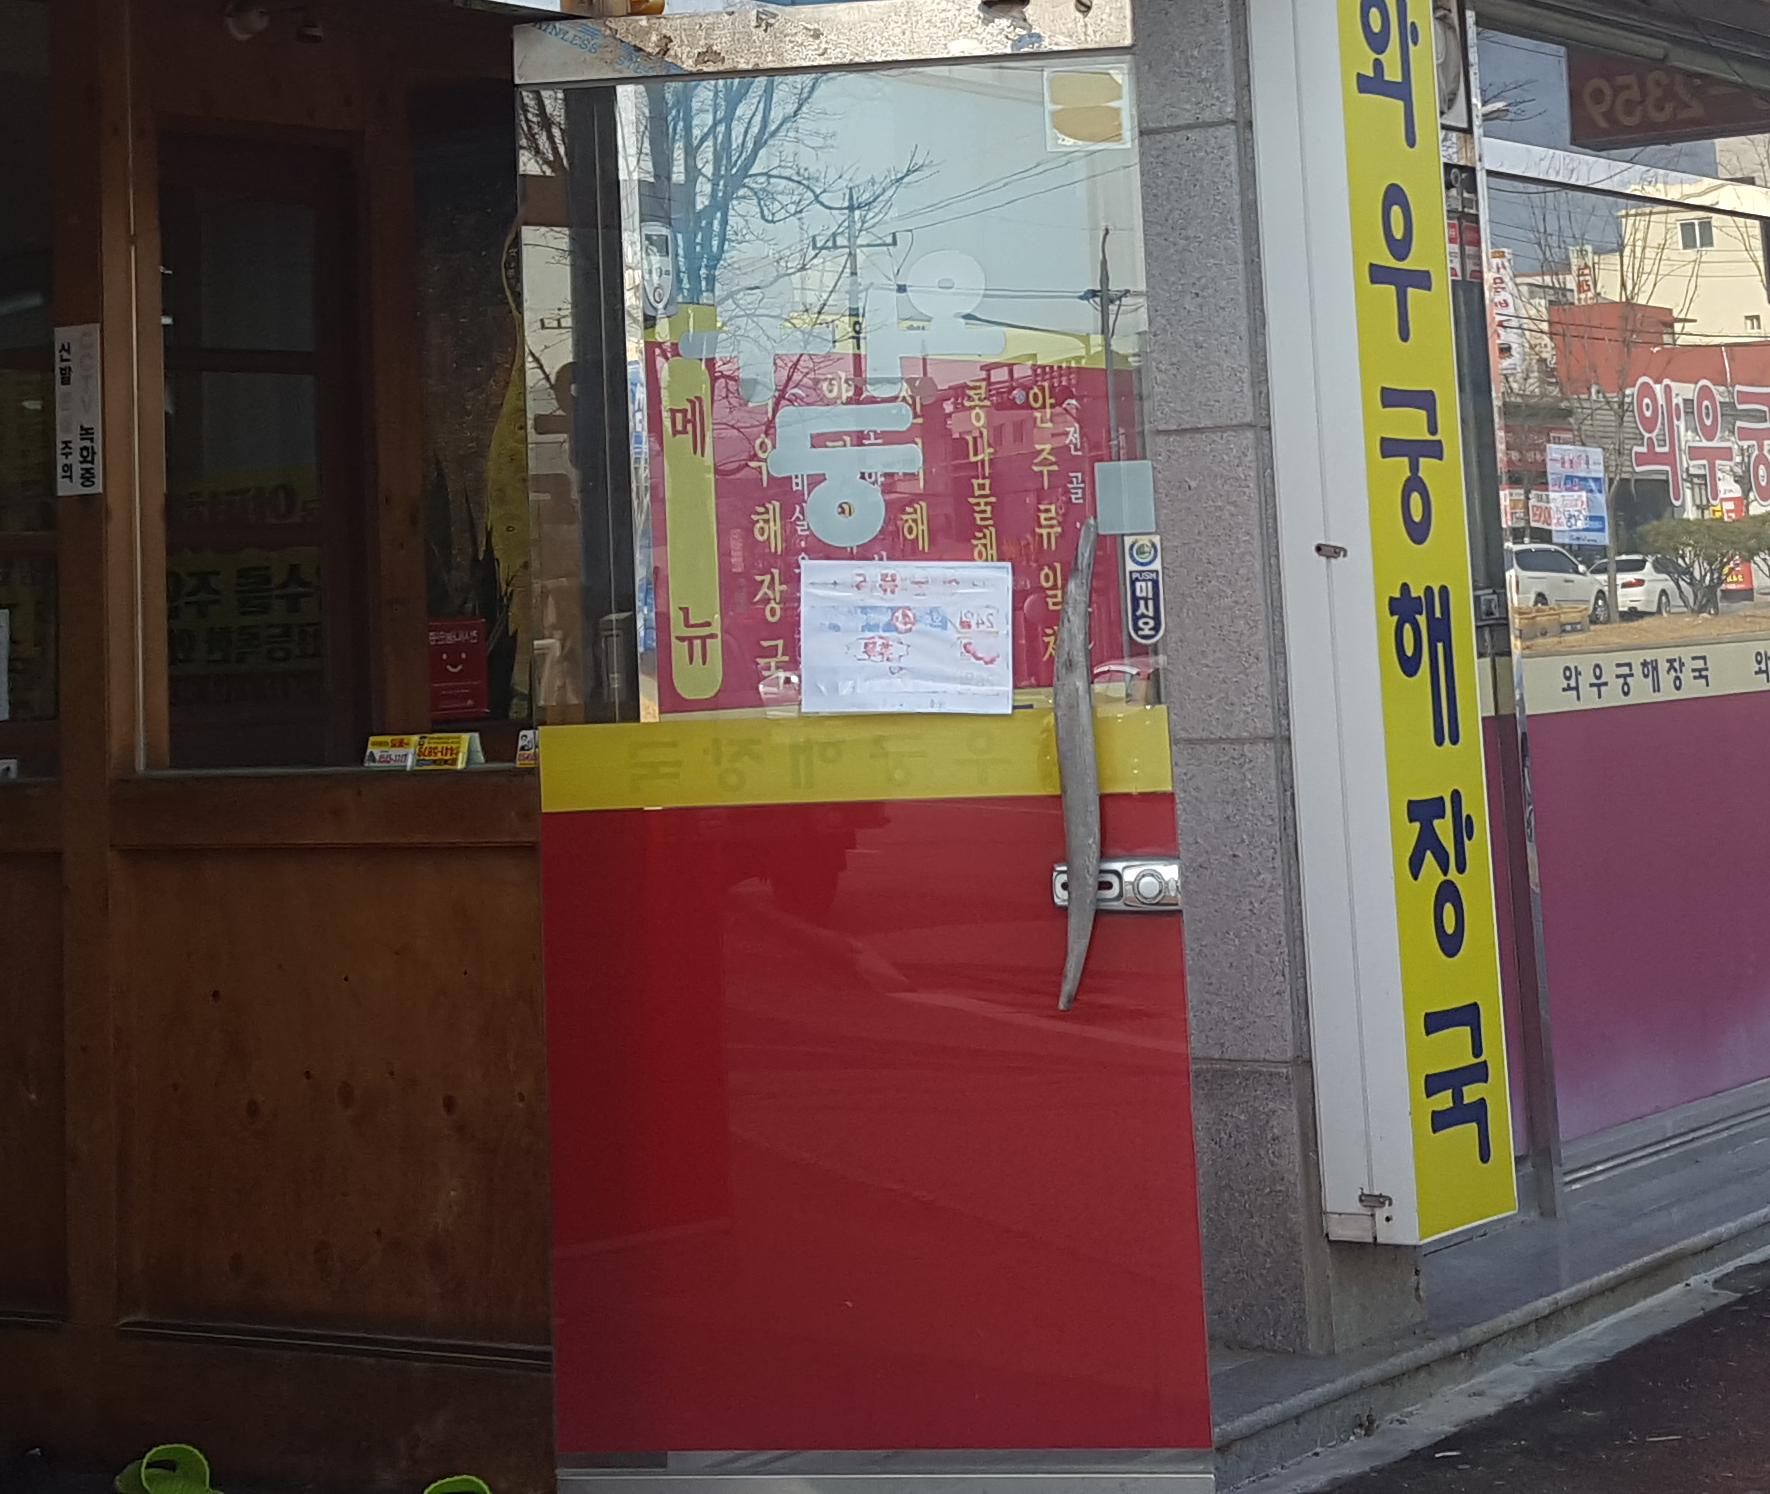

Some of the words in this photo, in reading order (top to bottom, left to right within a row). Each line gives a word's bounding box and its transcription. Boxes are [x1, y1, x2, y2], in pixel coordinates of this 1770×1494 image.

[668, 395, 721, 666] 메뉴
[1134, 581, 1158, 637] 미시오
[1561, 654, 1711, 702] 와우궁해장국
